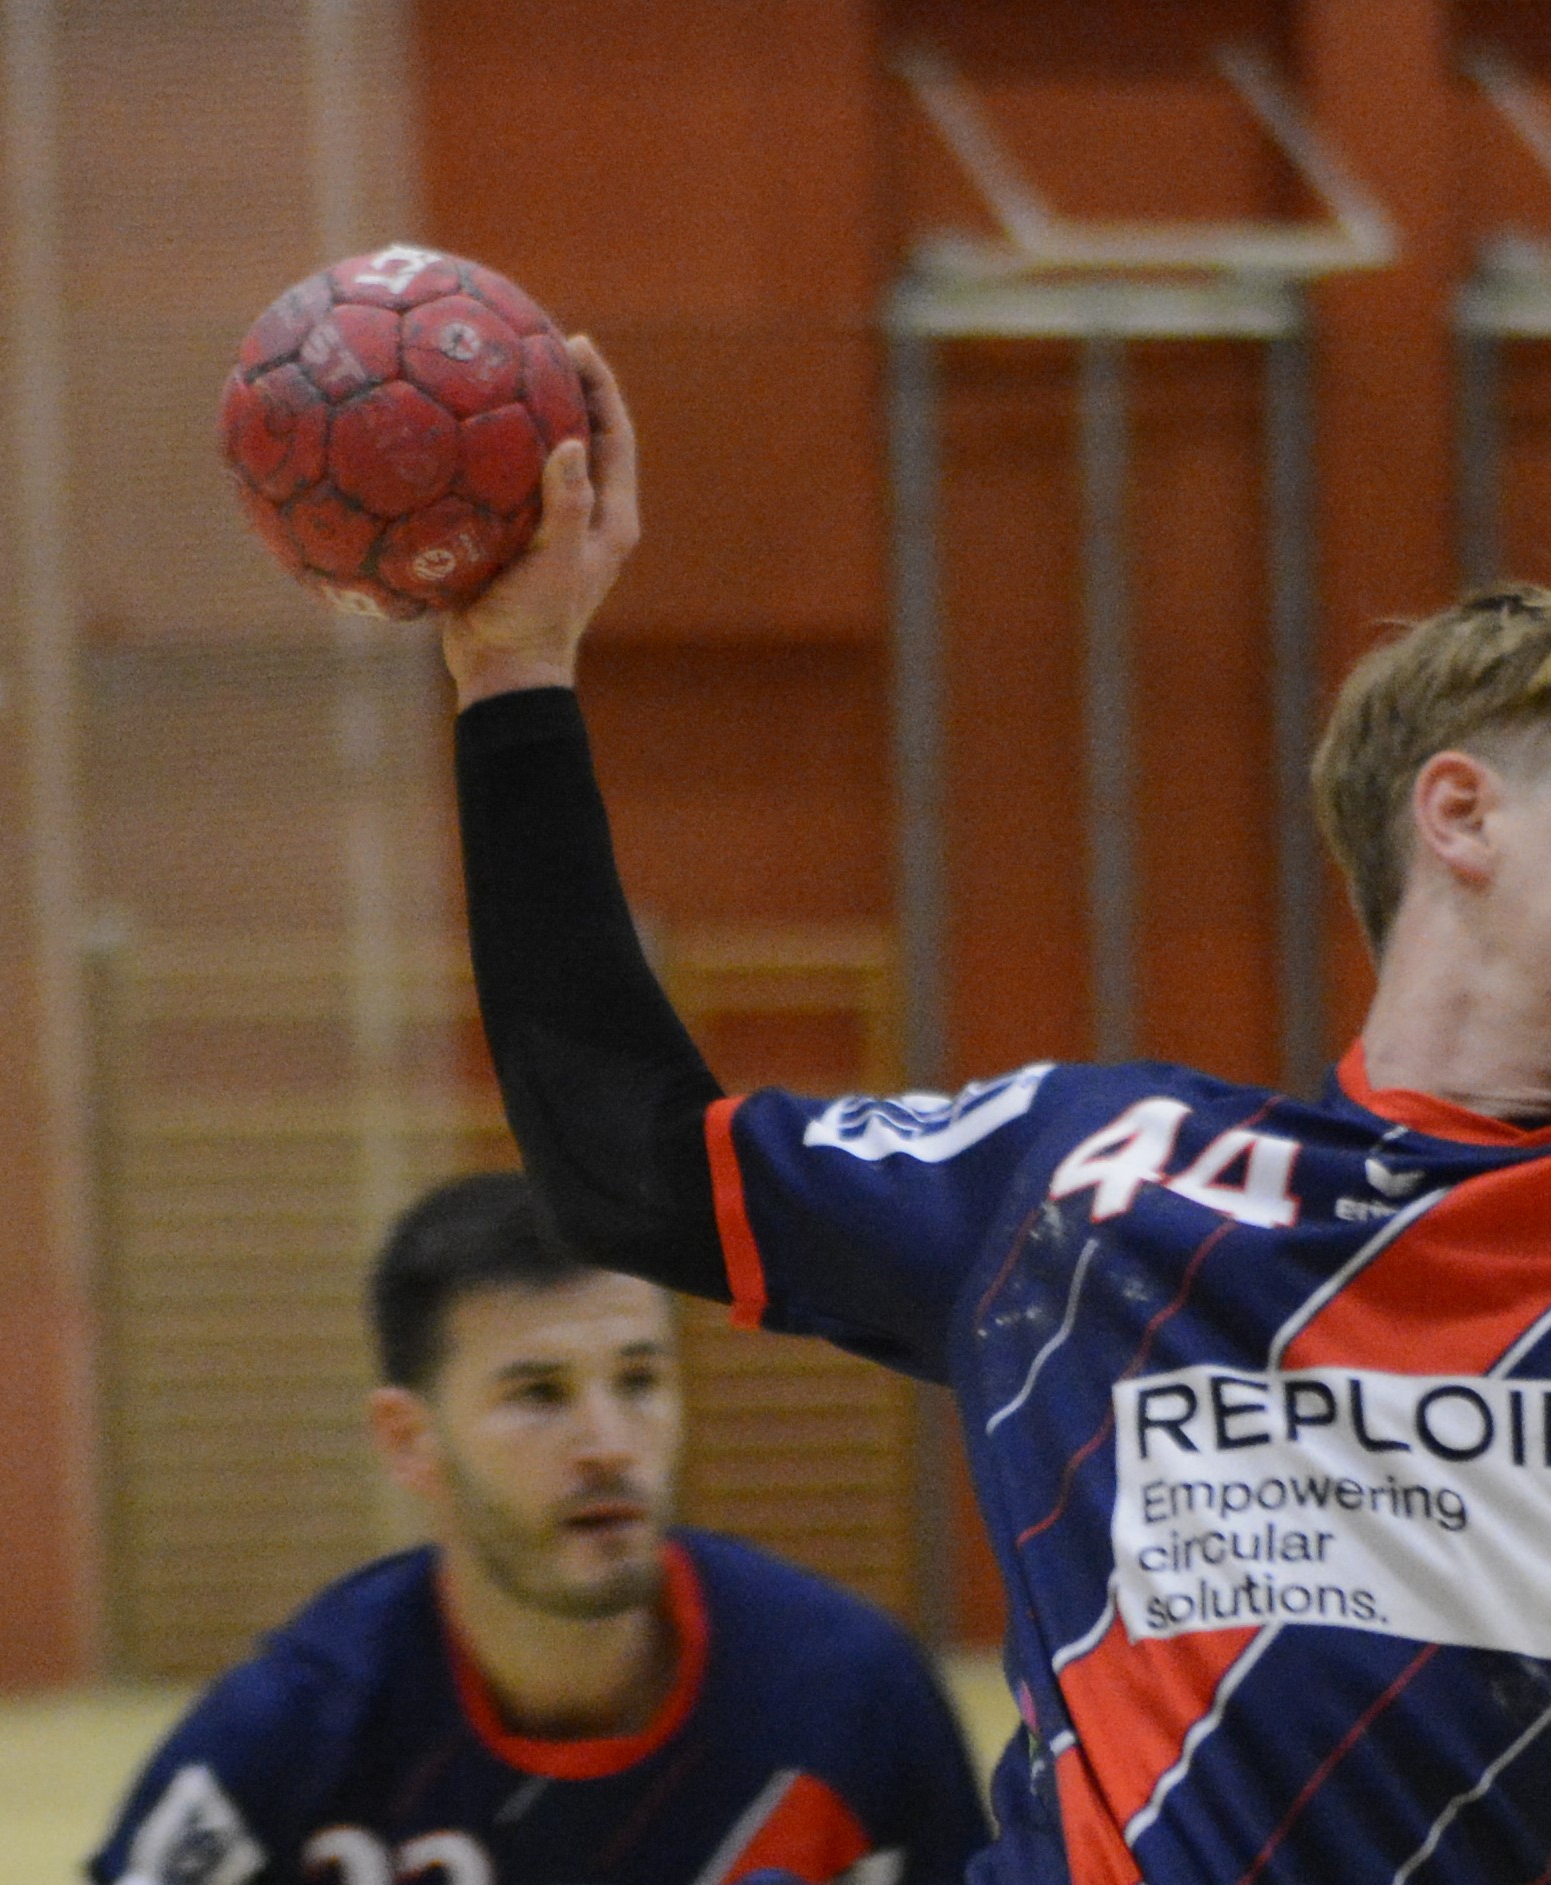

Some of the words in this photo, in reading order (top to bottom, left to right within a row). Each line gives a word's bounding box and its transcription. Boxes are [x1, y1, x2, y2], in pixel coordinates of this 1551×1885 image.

[1050, 1097, 1301, 1229] 44
[1142, 1474, 1469, 1532] Empowering
[1137, 1523, 1335, 1574] circular
[1146, 1574, 1389, 1631] solutions.
